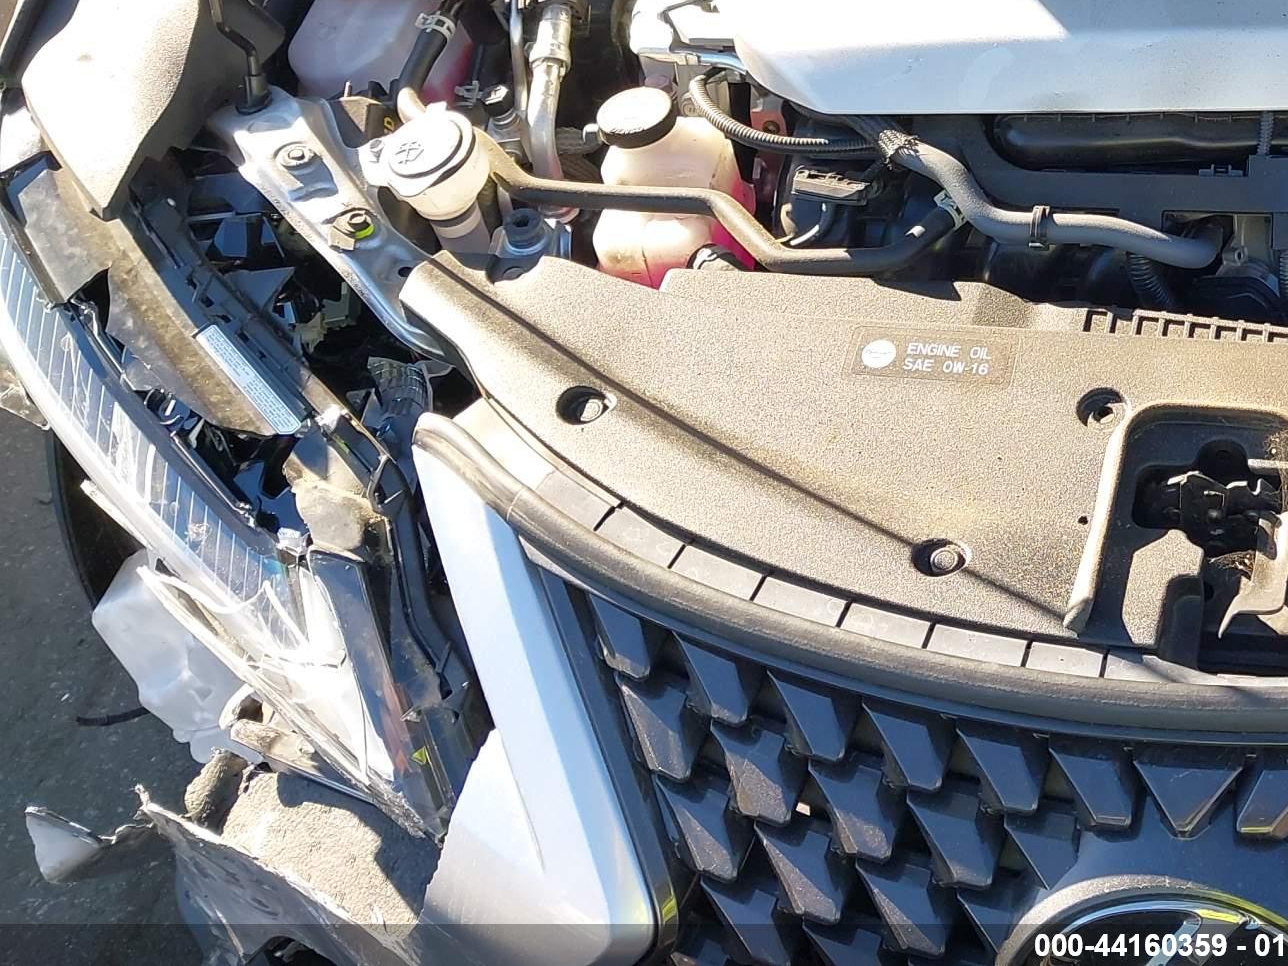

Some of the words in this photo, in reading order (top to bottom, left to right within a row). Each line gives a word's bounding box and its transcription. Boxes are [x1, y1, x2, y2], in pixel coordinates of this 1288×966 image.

[906, 342, 961, 358] ENGINE
[969, 346, 992, 360] OIL
[903, 358, 934, 372] SAE
[942, 360, 989, 375] 0W-16
